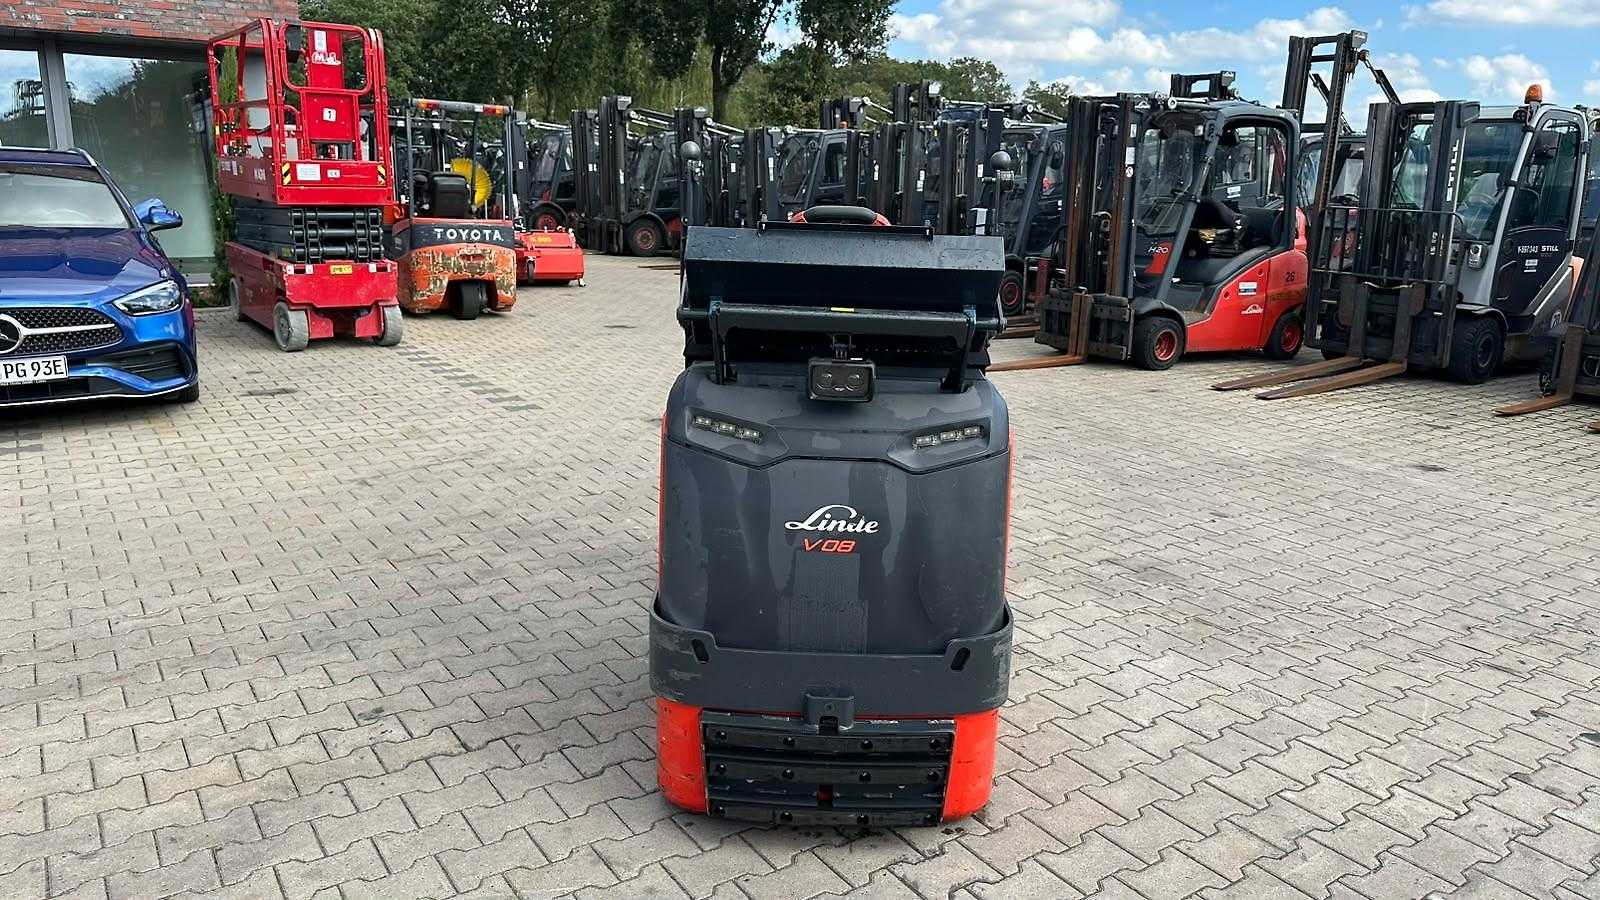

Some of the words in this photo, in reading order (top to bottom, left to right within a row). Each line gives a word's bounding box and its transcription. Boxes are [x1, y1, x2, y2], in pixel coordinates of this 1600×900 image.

[434, 228, 502, 241] TOYOTA
[1148, 246, 1169, 254] H20
[1286, 271, 1296, 282] 26
[3, 362, 27, 379] PG
[31, 359, 65, 378] 93E
[784, 504, 879, 534] Linde
